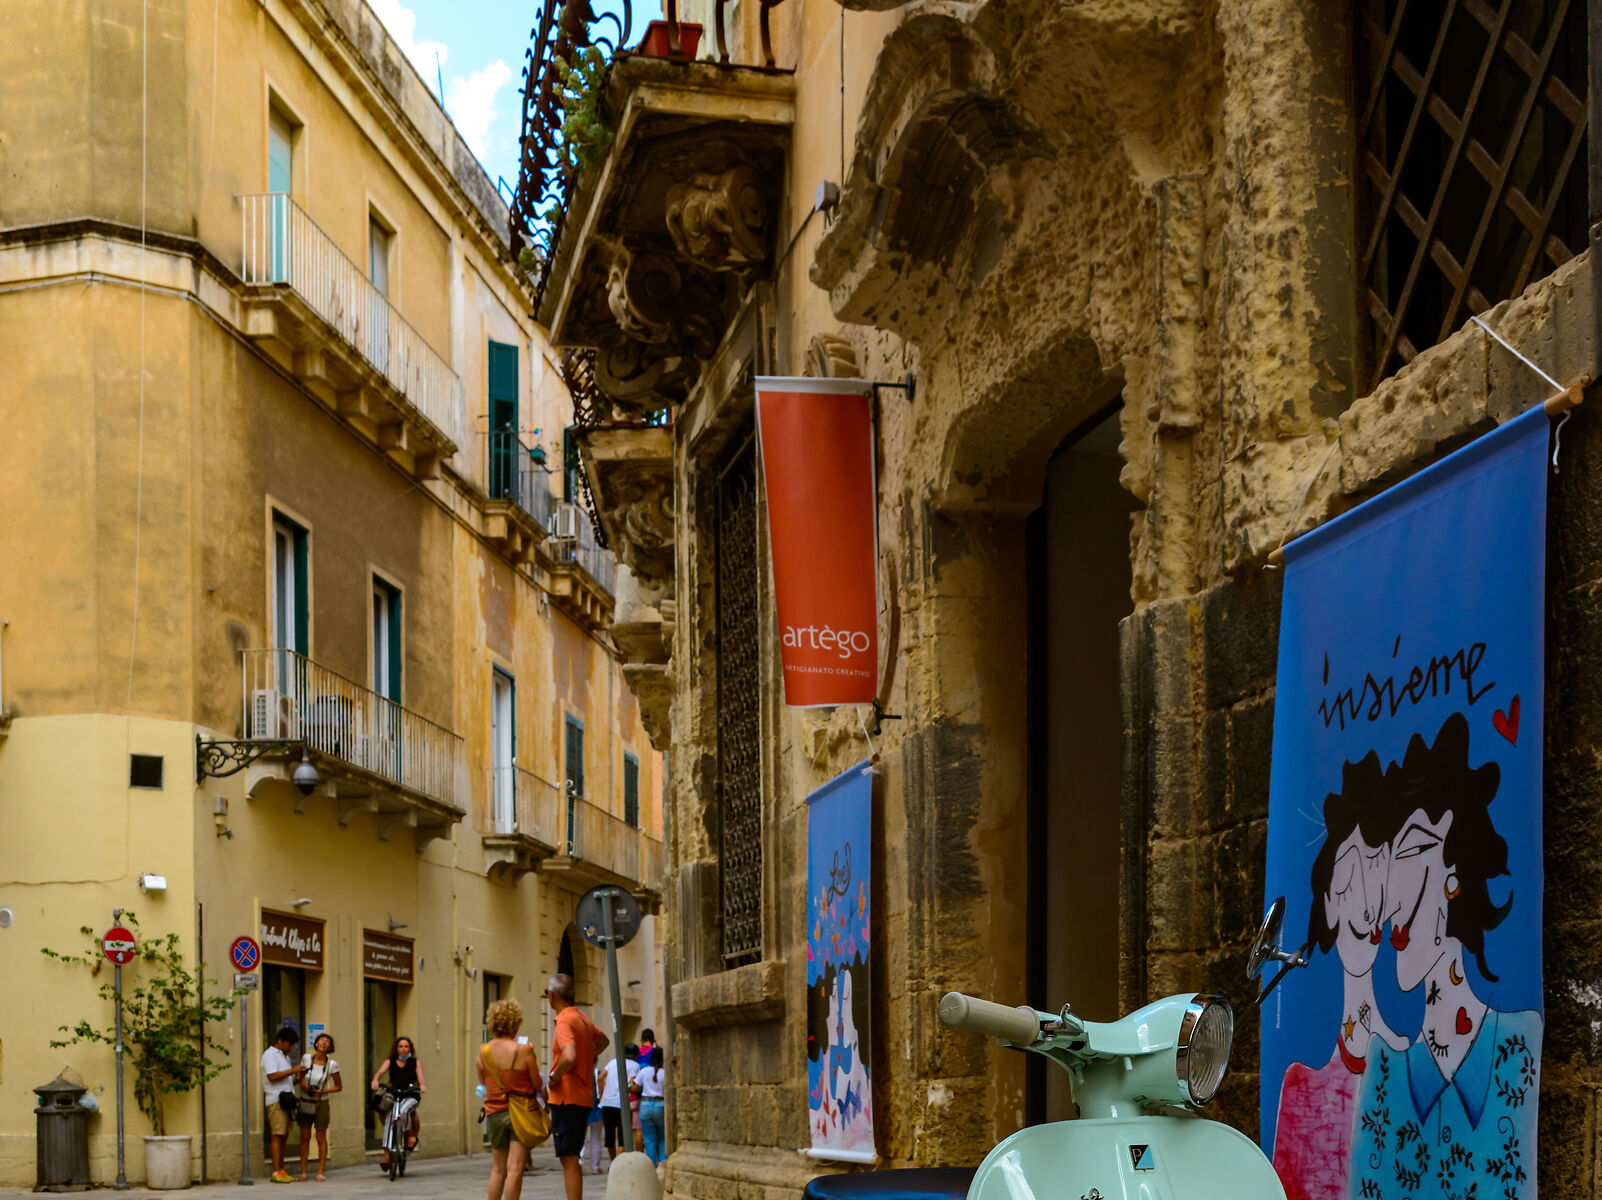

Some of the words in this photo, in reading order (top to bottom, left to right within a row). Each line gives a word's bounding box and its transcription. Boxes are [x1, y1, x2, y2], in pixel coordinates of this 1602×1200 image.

[783, 624, 870, 659] artègo
[836, 667, 871, 678] CREATIVO
[1318, 634, 1496, 731] insieme
[1132, 1148, 1142, 1163] P
